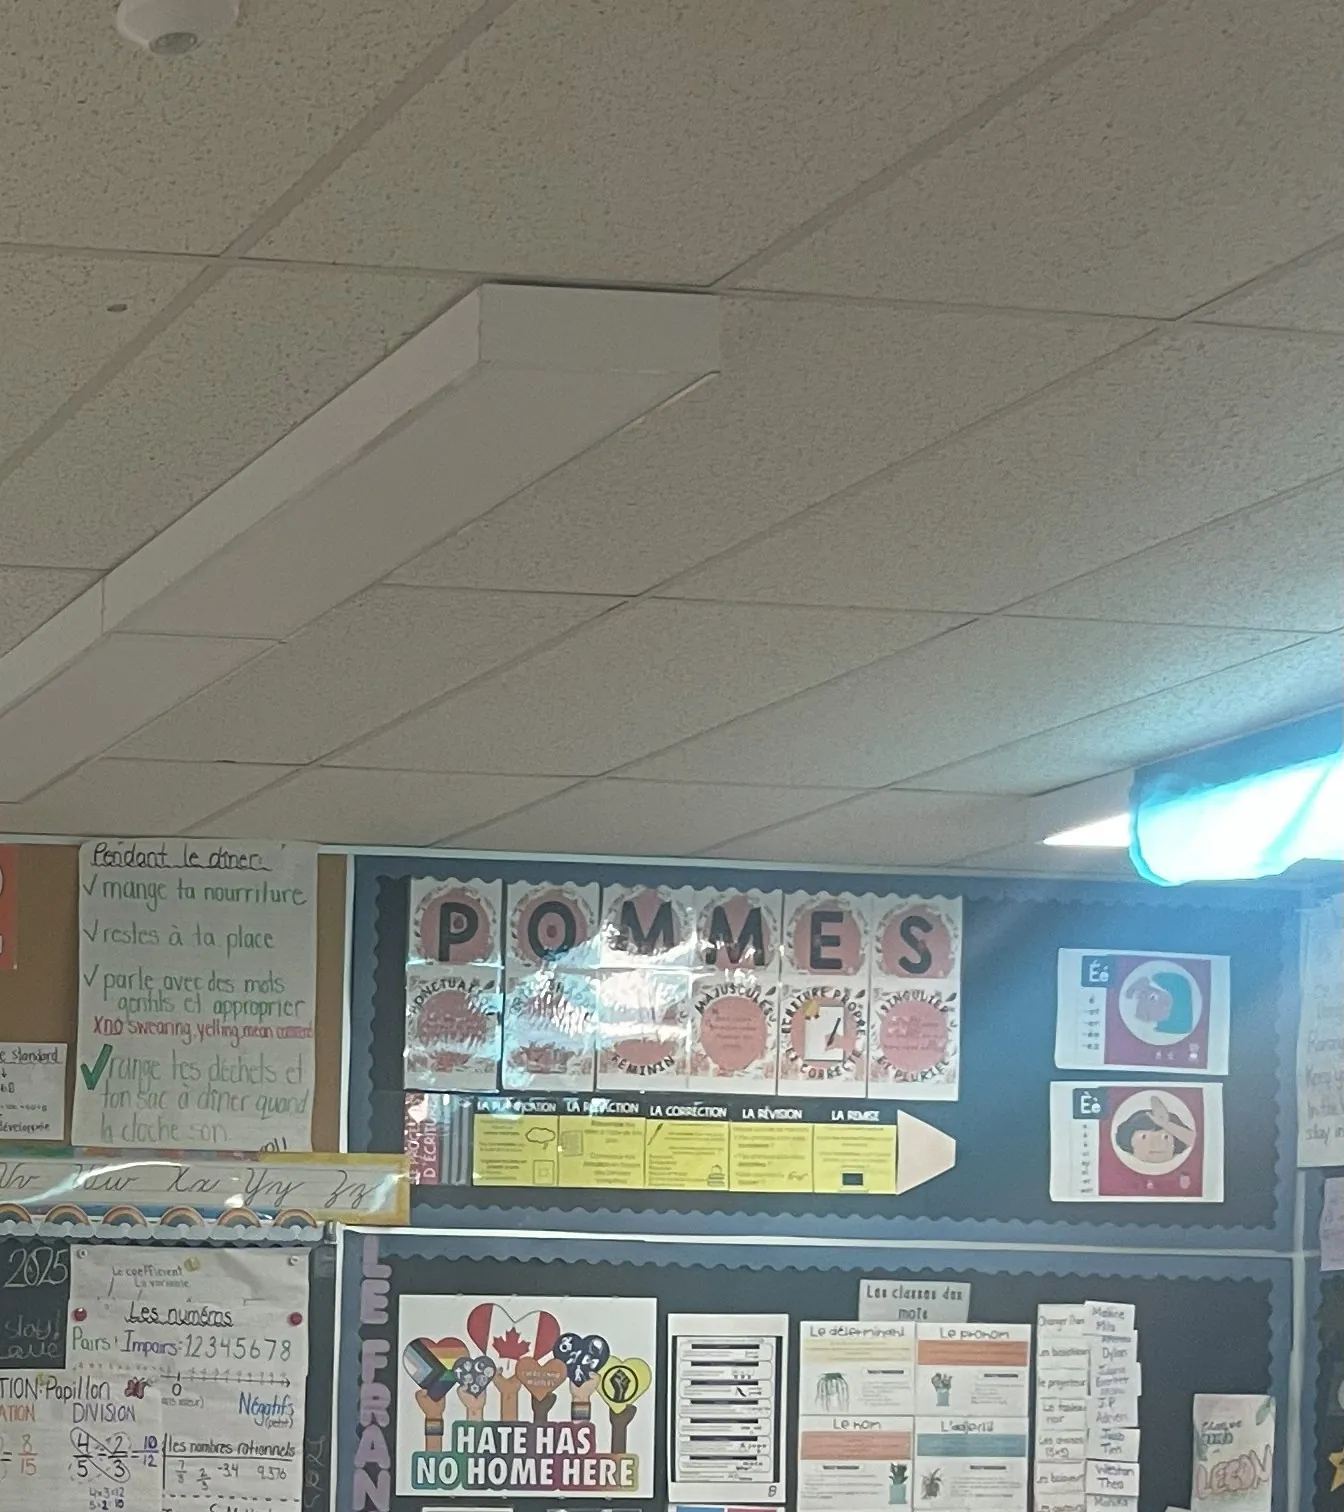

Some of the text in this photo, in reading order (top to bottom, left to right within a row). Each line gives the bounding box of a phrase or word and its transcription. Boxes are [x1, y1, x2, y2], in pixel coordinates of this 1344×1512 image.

[93, 841, 168, 869] Pendant
[102, 878, 308, 912] mange nourriture
[227, 924, 275, 958] place
[103, 965, 154, 1001] parle
[244, 969, 286, 993] mots
[1088, 959, 1110, 983] Éé
[212, 997, 307, 1021] approprier
[663, 1105, 803, 1120] CORRECTION RÉVISION
[4, 1248, 72, 1288] 2025
[359, 1234, 393, 1325] LE
[128, 1301, 158, 1322] Les
[960, 1328, 1010, 1341] pronom
[45, 1375, 111, 1402] Papillon
[72, 1402, 137, 1423] DIVISION
[238, 1391, 295, 1426] Négatifs
[854, 1419, 882, 1430] nom
[189, 1439, 296, 1458] nombres rationnels
[457, 1426, 592, 1456] HATE HAS
[416, 1456, 635, 1487] NO HOME HERE
